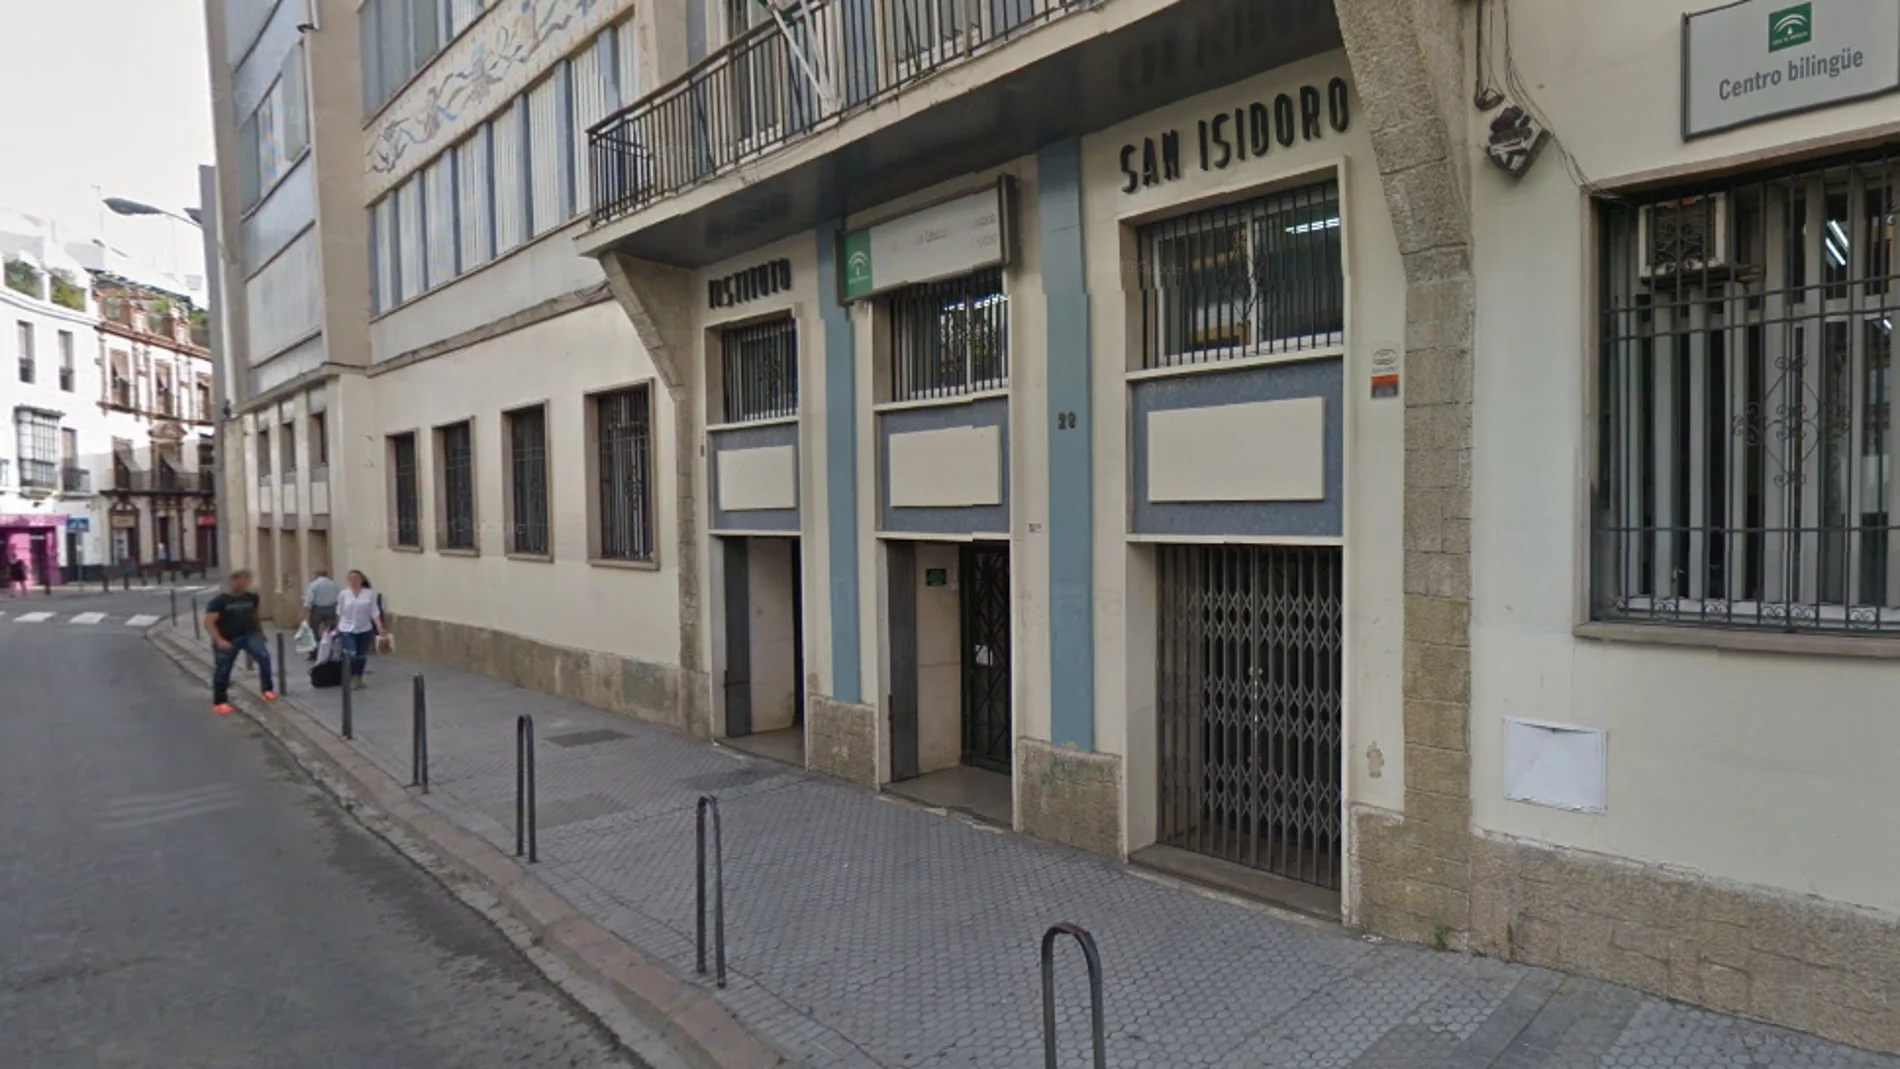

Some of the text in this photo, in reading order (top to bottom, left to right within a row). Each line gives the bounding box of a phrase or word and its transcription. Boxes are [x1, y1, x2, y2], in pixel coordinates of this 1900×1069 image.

[1719, 47, 1863, 101] Centro bilingüe
[1120, 76, 1350, 194] SAN ISIDORO
[708, 258, 792, 310] INSTITUTO
